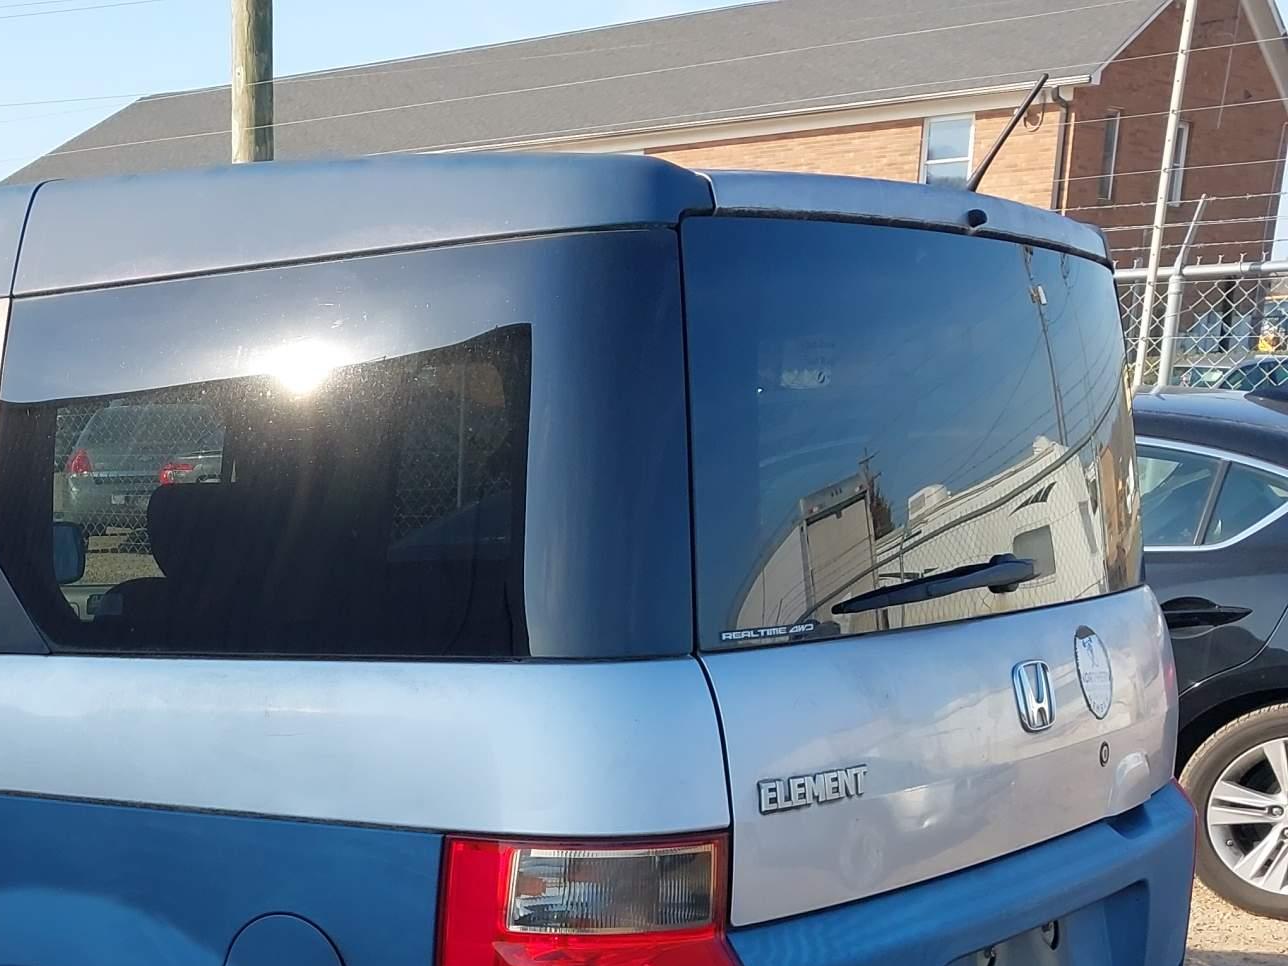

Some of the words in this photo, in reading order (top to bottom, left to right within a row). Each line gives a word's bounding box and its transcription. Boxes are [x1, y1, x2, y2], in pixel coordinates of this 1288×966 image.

[721, 626, 787, 640] REALTIME
[789, 623, 814, 634] 4WD
[758, 765, 868, 814] ELEMENT
